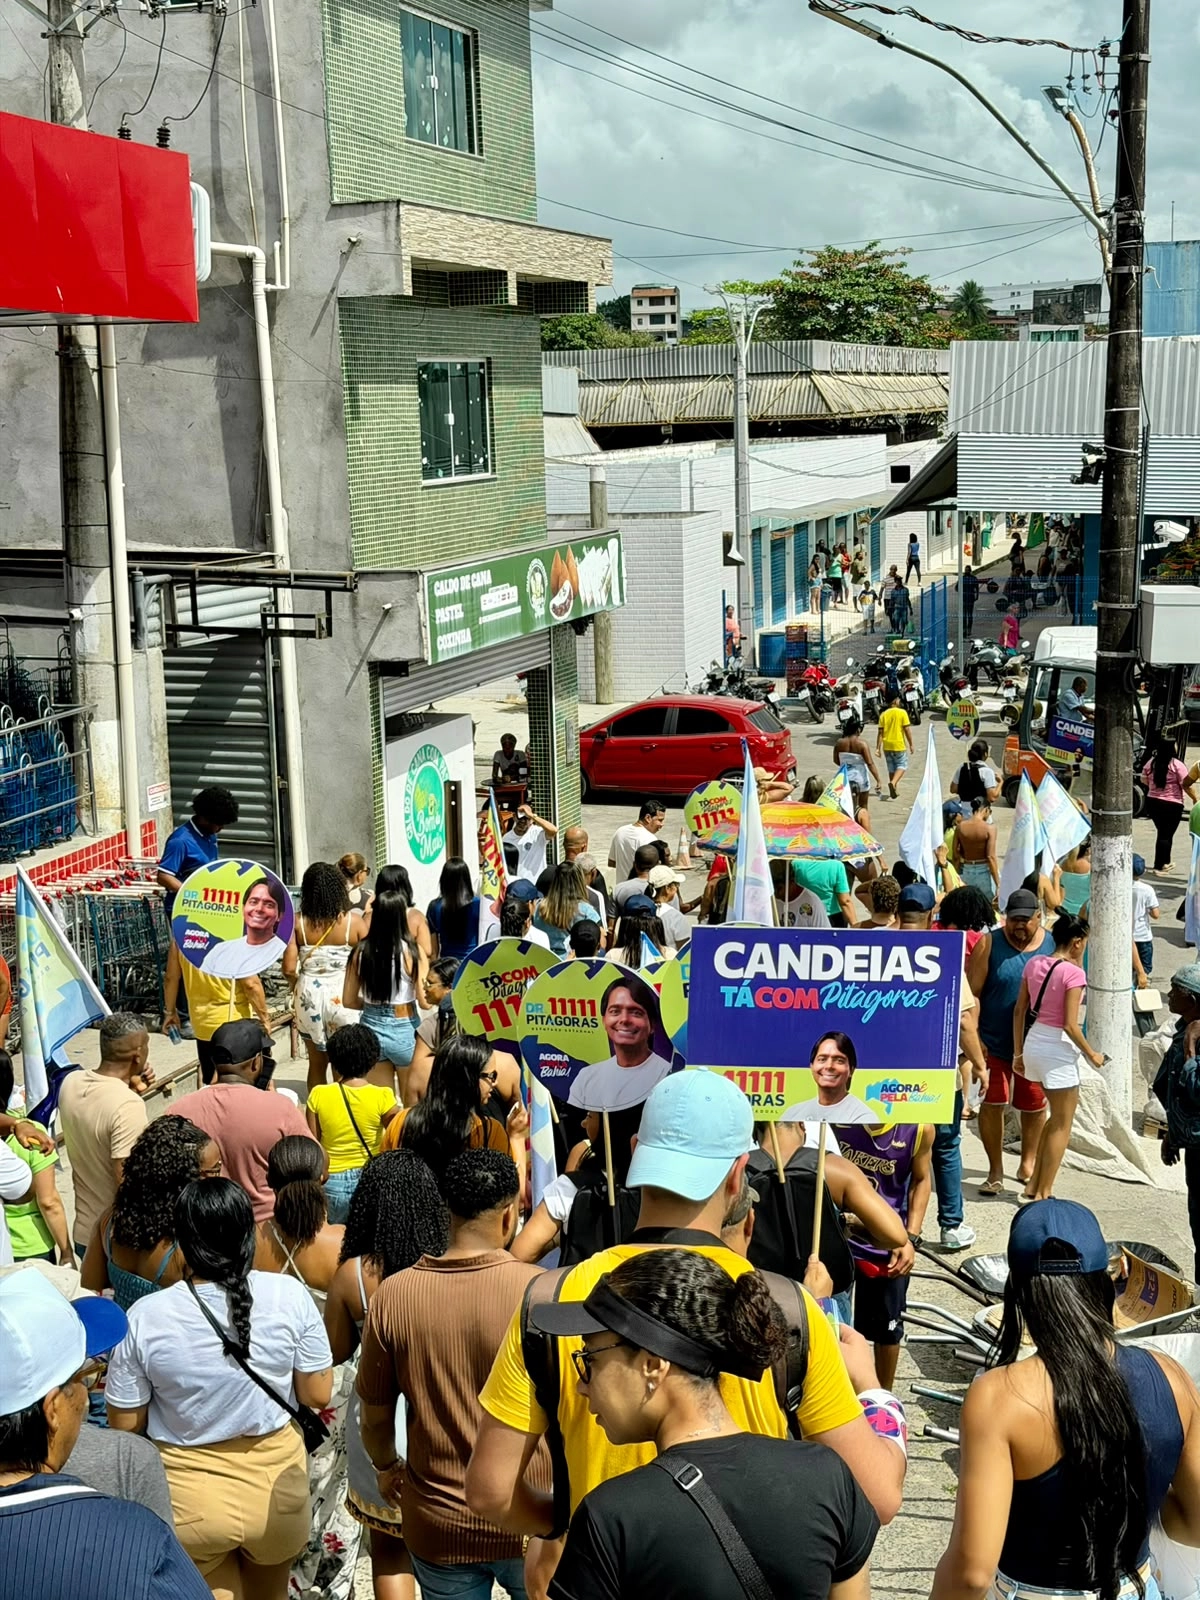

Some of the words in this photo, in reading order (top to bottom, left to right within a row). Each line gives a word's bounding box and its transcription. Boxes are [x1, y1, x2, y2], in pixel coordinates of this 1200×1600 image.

[434, 577, 459, 597] CALDO
[459, 574, 471, 591] DE
[471, 569, 492, 588] CANA
[435, 603, 464, 624] PASTEL
[437, 627, 472, 651] COXINHA
[183, 890, 198, 899] DR
[202, 887, 241, 905] 11111
[713, 942, 941, 982] CANDEIAS
[526, 1003, 544, 1014] DR
[547, 997, 597, 1017] 11111
[754, 986, 819, 1010] COM
[539, 1053, 570, 1063] AGORA
[880, 1093, 908, 1102] PELA
[881, 1083, 921, 1093] AGORA
[839, 1141, 897, 1175] LAKERS
